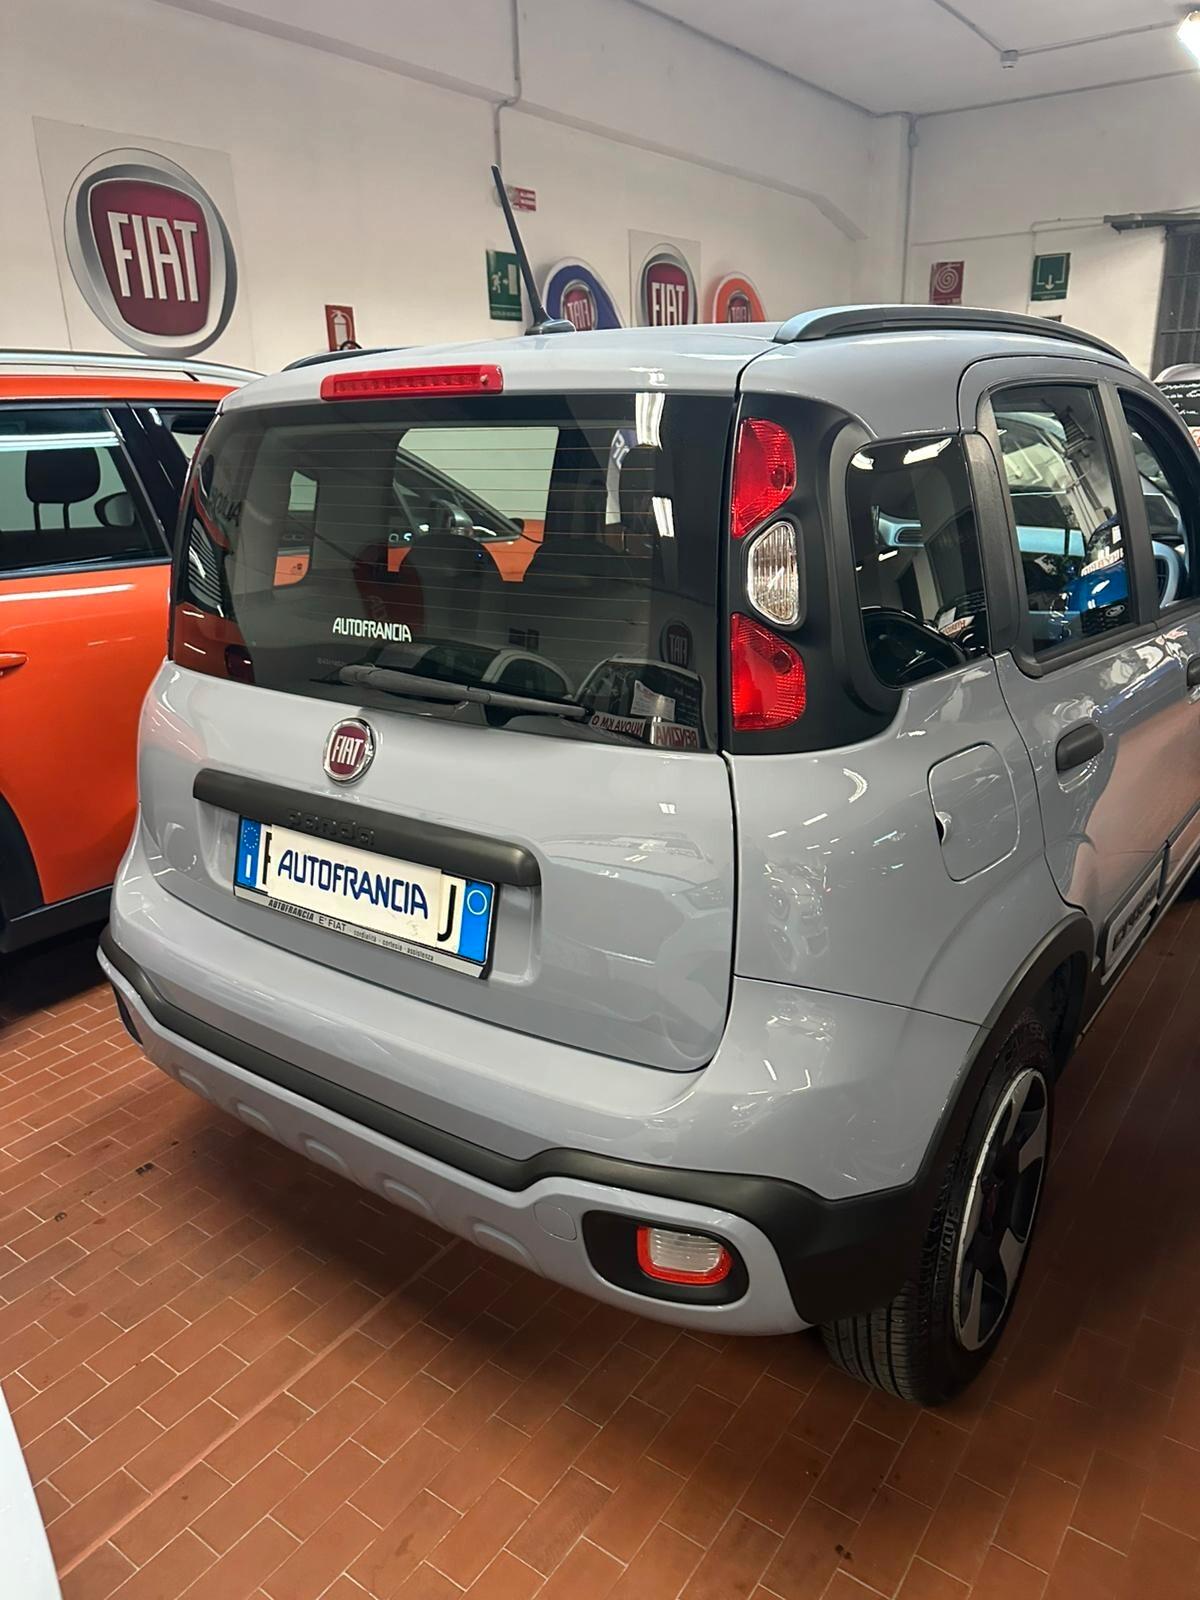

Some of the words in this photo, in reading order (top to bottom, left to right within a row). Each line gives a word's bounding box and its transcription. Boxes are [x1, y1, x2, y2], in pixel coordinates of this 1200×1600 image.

[107, 211, 199, 302] FIAT
[651, 282, 686, 326] FIAT
[332, 617, 412, 643] AUTOFRANCIA
[331, 734, 364, 766] FIAT
[278, 849, 429, 920] AUTOFRANCIA
[267, 899, 315, 922] AUTOFRANCIA
[328, 919, 347, 933] FIAT
